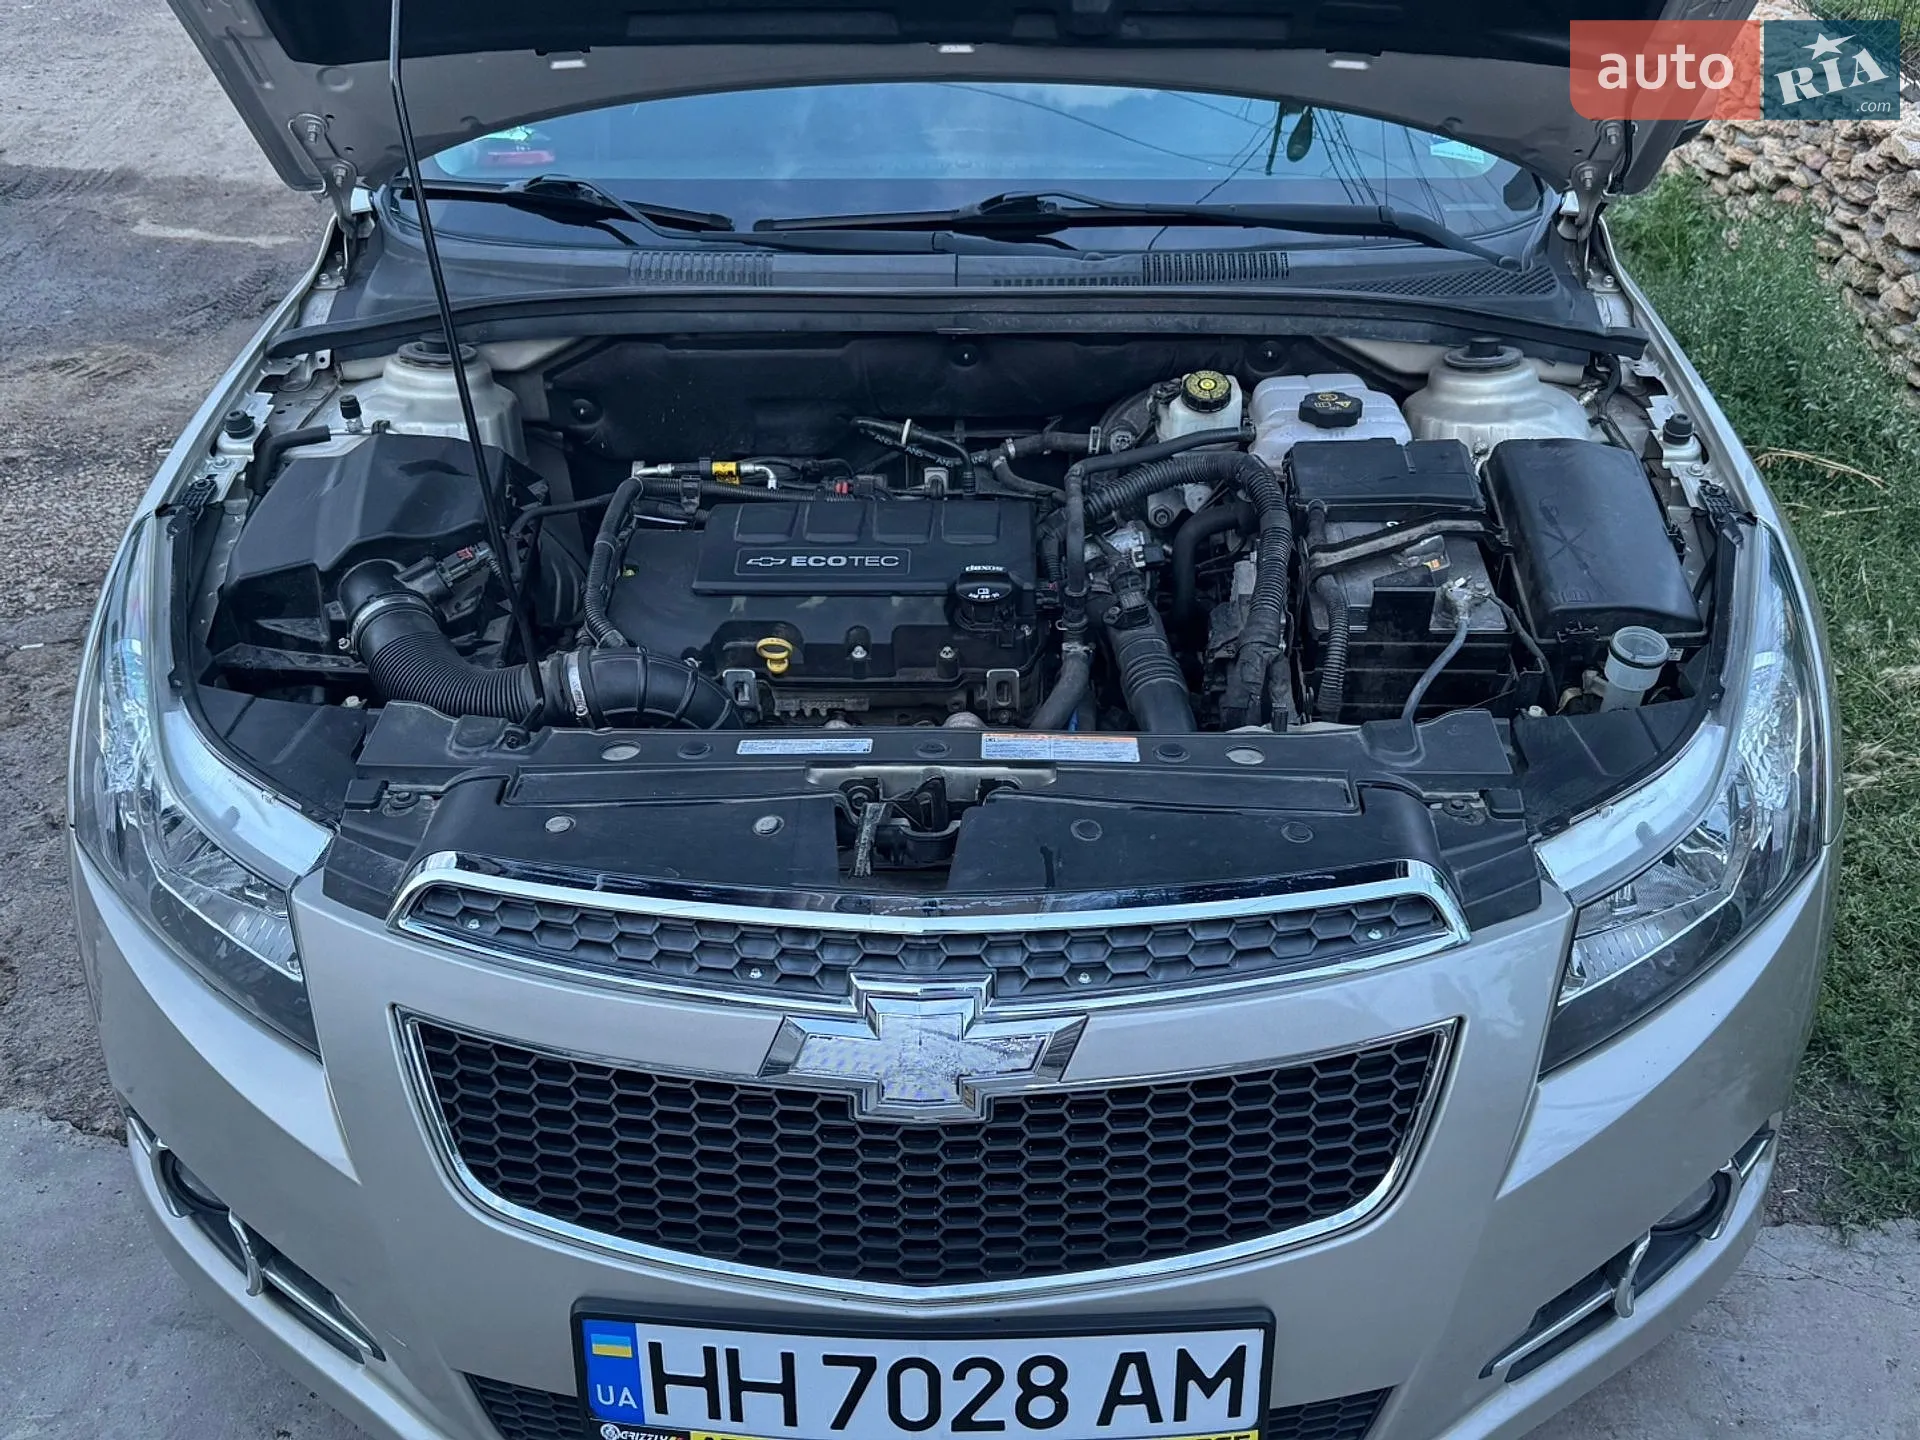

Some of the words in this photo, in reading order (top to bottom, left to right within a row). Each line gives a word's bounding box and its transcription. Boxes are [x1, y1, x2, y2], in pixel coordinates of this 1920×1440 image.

[791, 556, 900, 567] ECOTEC
[596, 1384, 638, 1409] UA
[648, 1341, 798, 1428] HH
[821, 1354, 1070, 1433] 7028
[1096, 1344, 1248, 1427] AM
